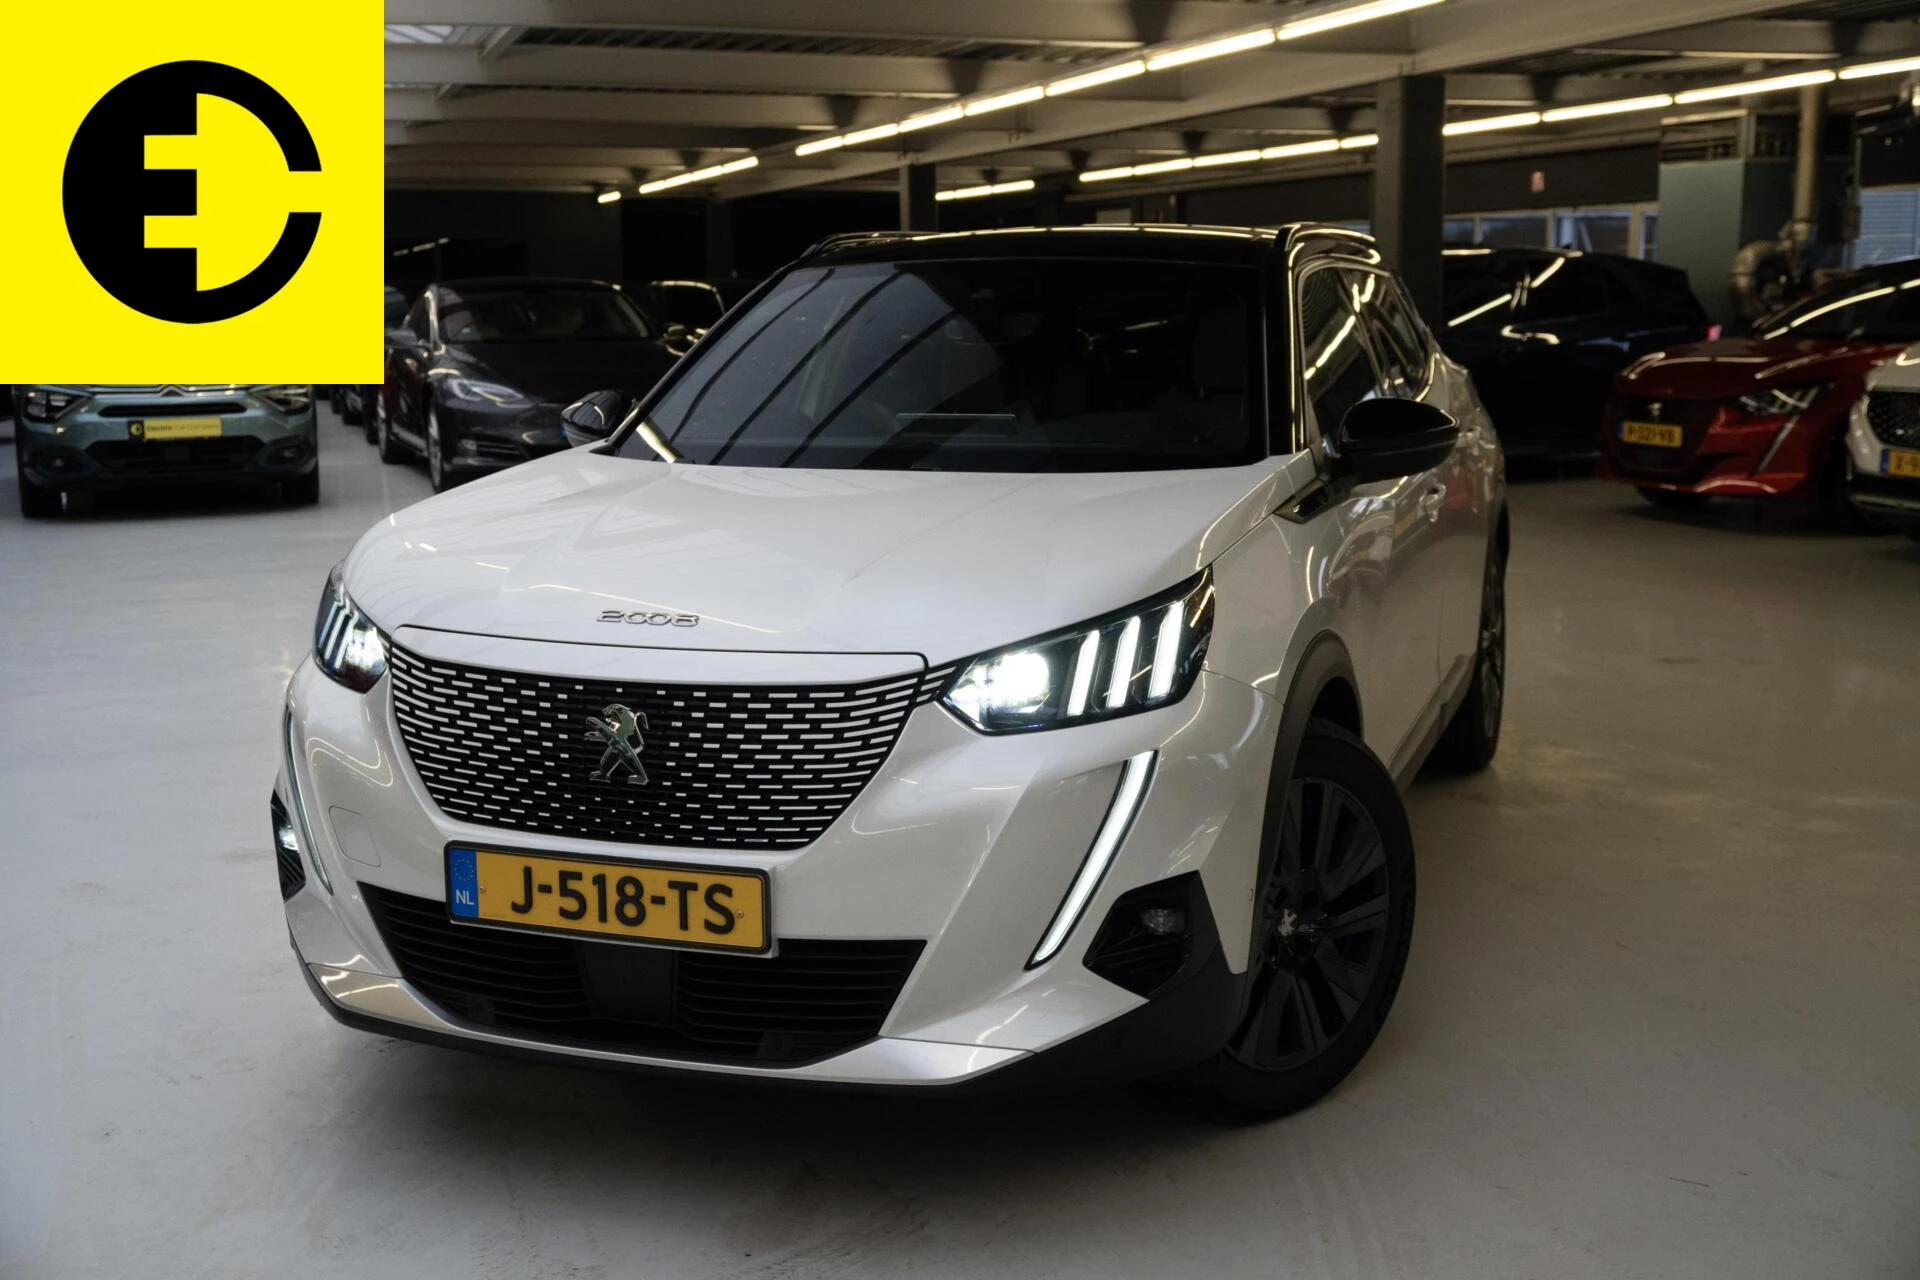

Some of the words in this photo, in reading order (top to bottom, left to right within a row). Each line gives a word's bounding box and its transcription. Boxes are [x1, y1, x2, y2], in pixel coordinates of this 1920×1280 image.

[597, 610, 699, 627] 2008
[455, 888, 475, 906] NL
[511, 865, 736, 935] J-518-TS
